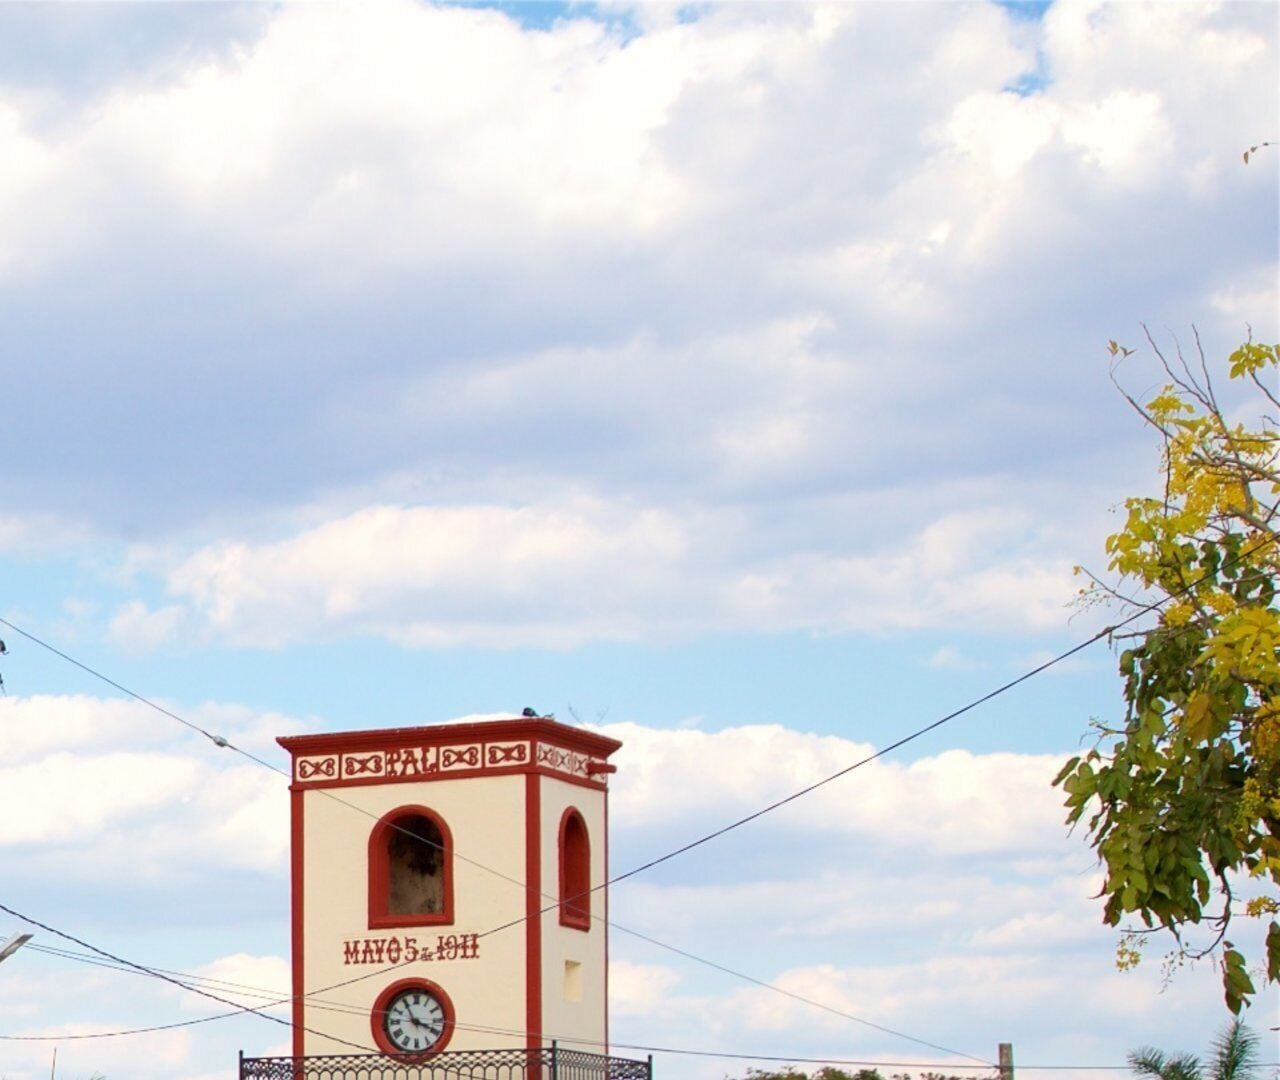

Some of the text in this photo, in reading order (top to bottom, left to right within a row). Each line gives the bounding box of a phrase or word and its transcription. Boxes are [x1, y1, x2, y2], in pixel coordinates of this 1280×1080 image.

[387, 747, 438, 776] PAL
[343, 936, 402, 965] MAYO
[404, 937, 419, 962] 5
[437, 933, 479, 960] 1911
